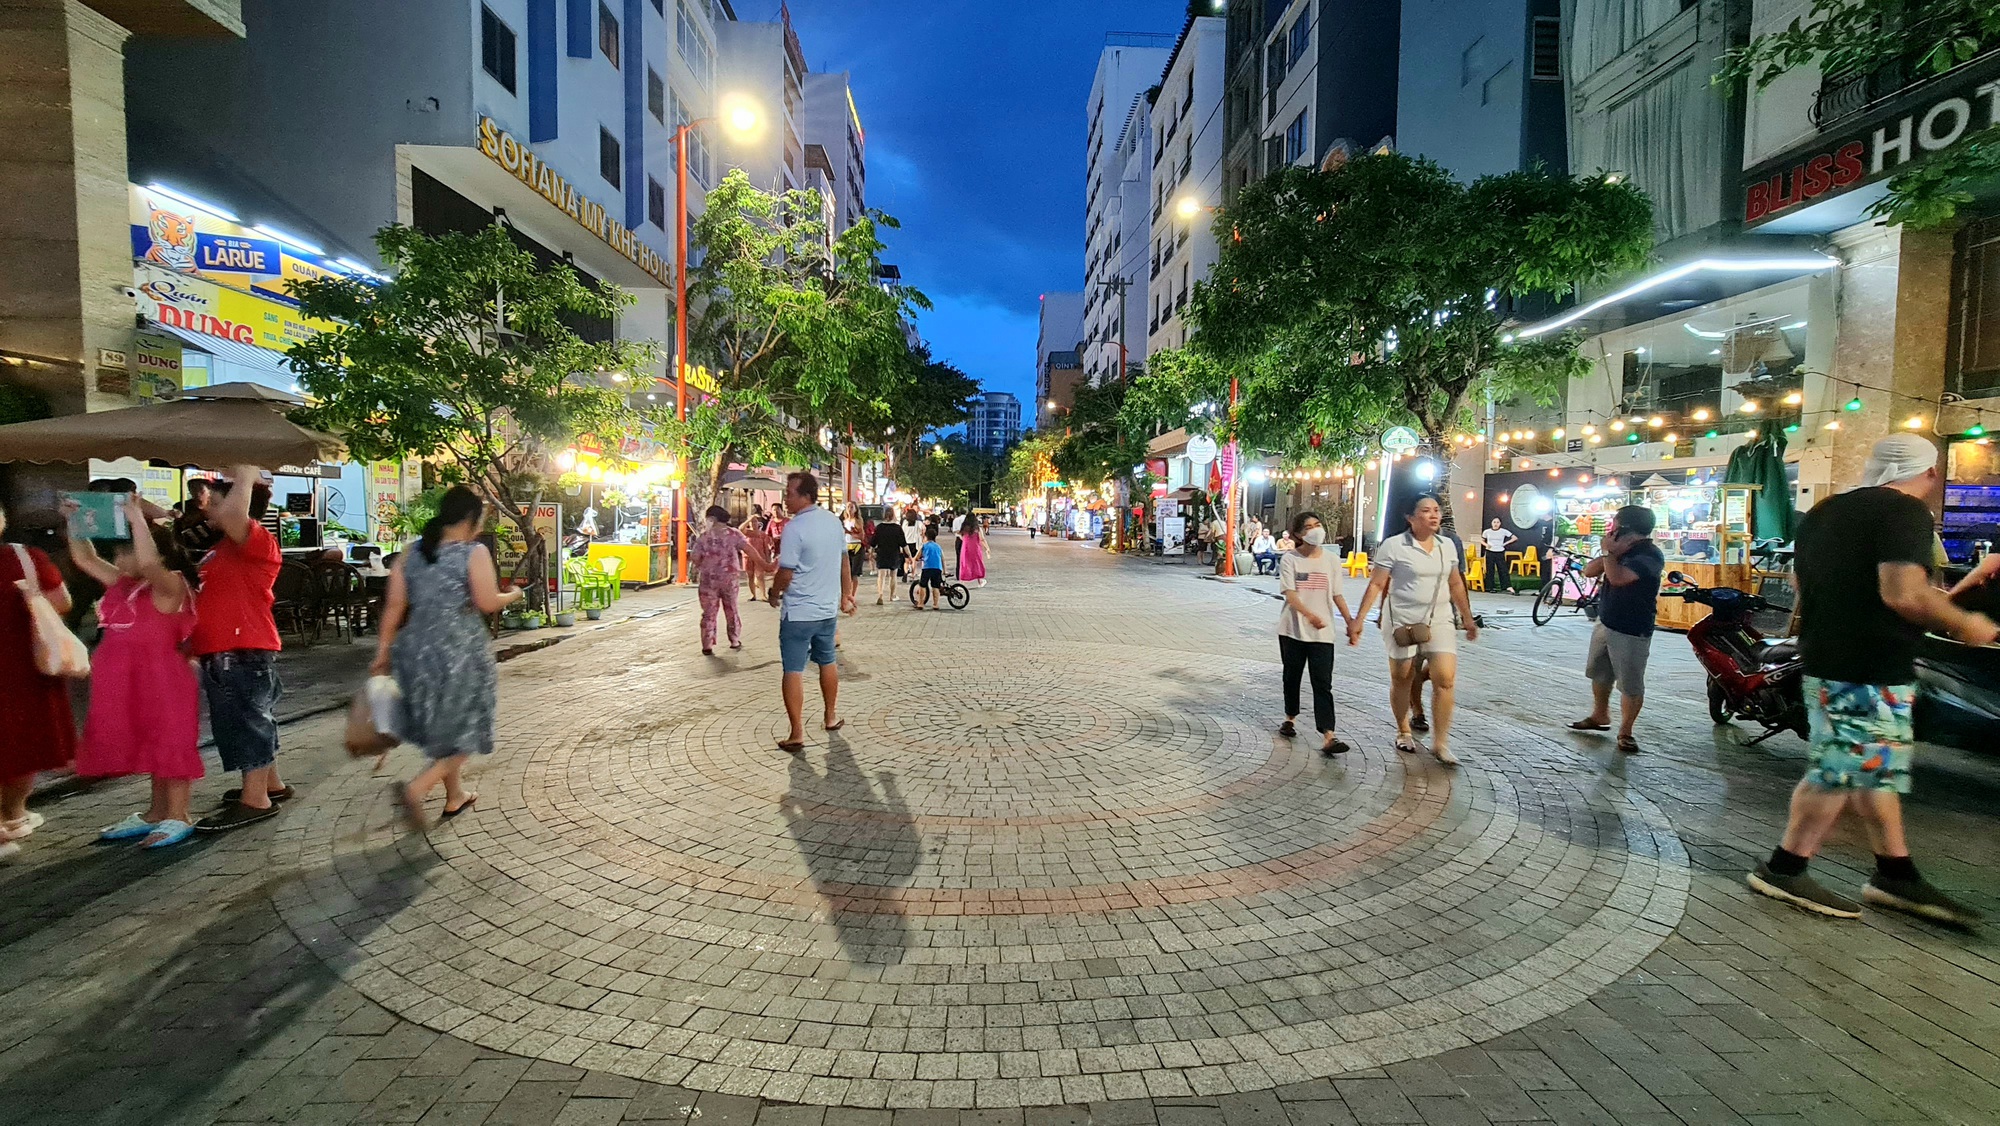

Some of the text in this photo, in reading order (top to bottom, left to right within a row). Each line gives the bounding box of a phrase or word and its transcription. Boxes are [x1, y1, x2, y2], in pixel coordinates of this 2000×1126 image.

[1745, 140, 1864, 223] BLISS
[481, 117, 580, 220] SOFIANA
[638, 241, 673, 288] HOTEL
[203, 246, 266, 270] LARUE
[228, 240, 240, 248] BIA
[157, 302, 254, 345] DUNG
[104, 352, 124, 364] 89
